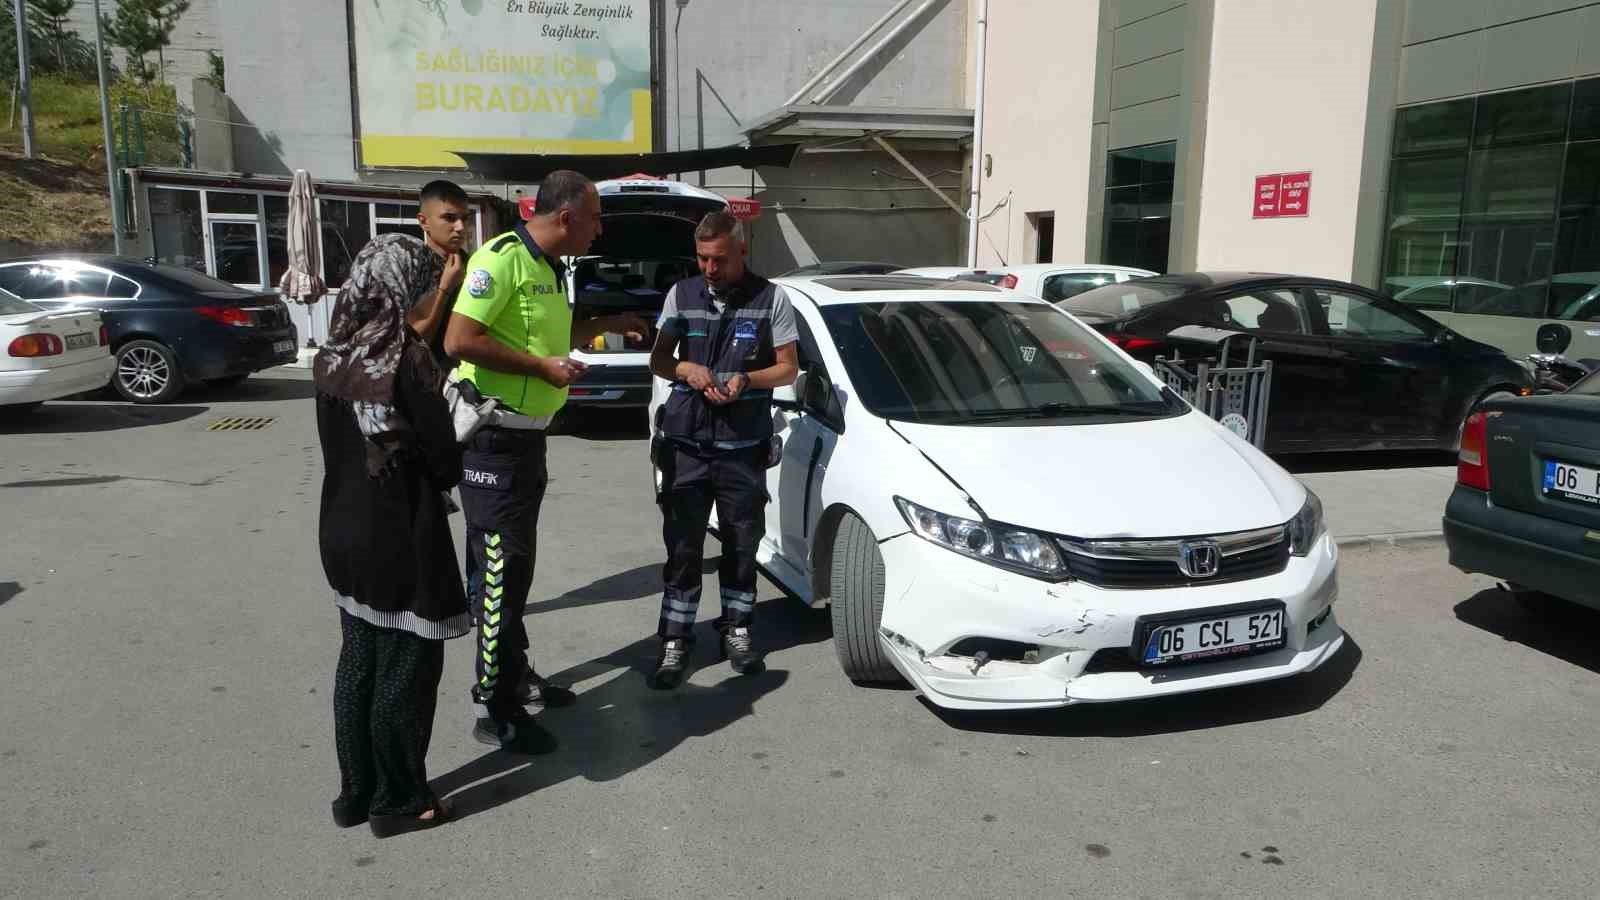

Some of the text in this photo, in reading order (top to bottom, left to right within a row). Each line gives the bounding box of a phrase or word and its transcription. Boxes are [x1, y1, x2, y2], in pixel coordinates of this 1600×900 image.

[506, 0, 633, 21] En Büyük Zenginlik
[540, 24, 600, 41] Sağlıktır.
[416, 47, 546, 76] SAĞLIĞINIZ
[415, 82, 599, 117] BURADAYIZ
[1556, 466, 1578, 489] 06
[1160, 611, 1281, 654] 06 CSL 521
